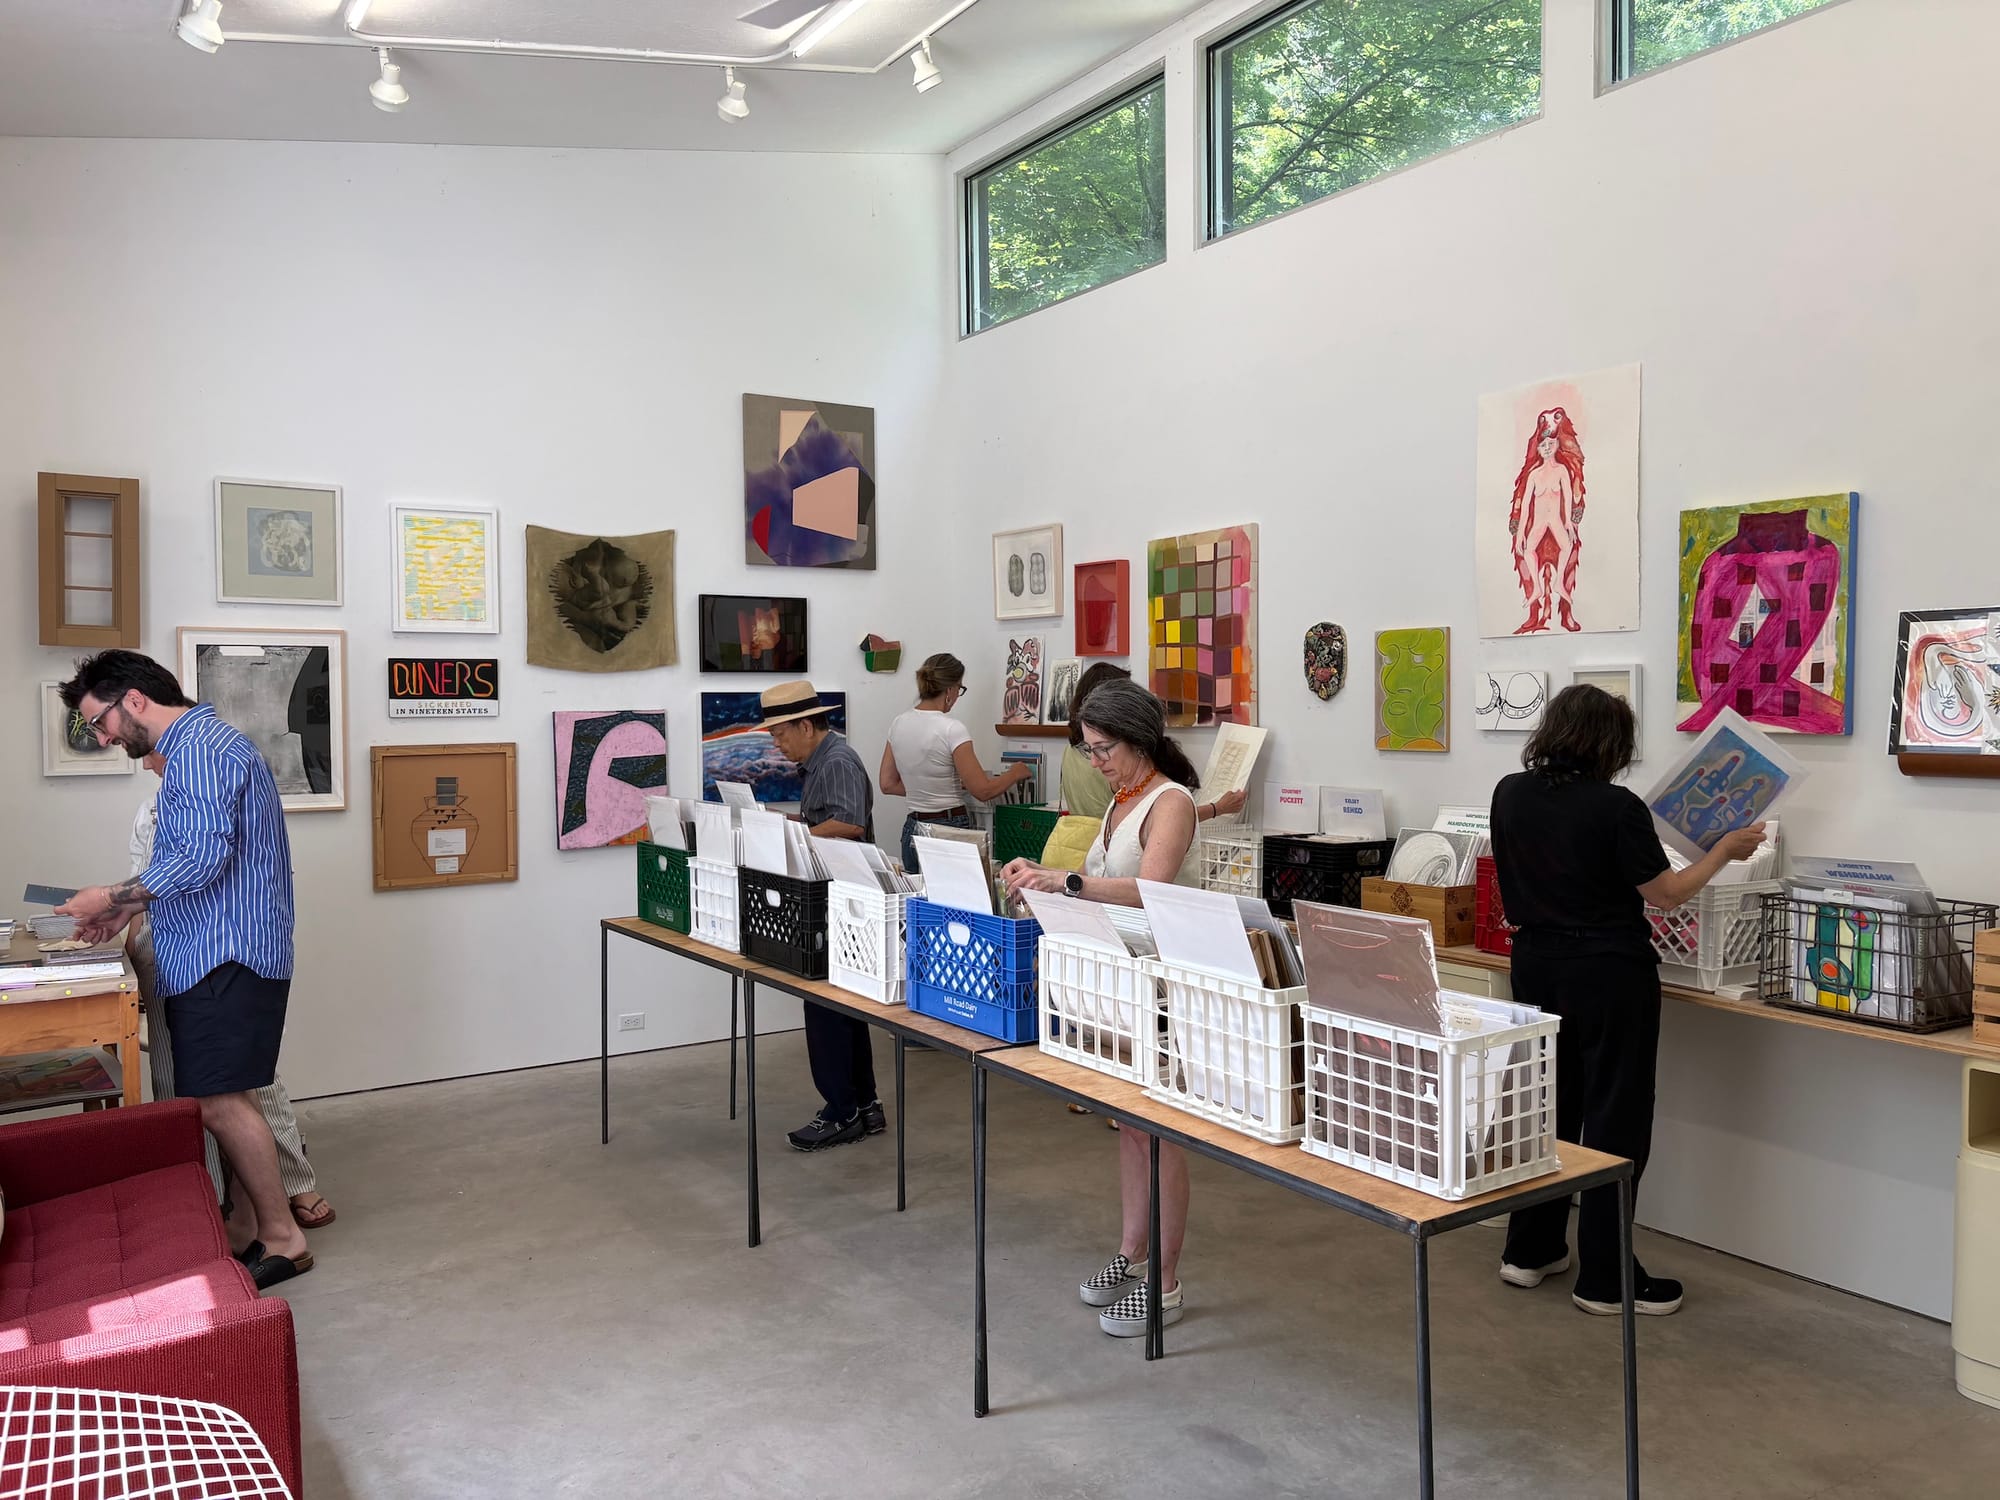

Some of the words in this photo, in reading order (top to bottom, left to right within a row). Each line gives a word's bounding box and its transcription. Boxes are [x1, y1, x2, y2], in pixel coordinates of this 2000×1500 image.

[393, 661, 494, 698] DINERS
[417, 701, 472, 709] SICKENED
[1279, 796, 1304, 805] PUCKETT
[1825, 870, 1895, 881] WEHRMANN
[943, 995, 953, 1005] Mill
[965, 1001, 978, 1014] Dairy
